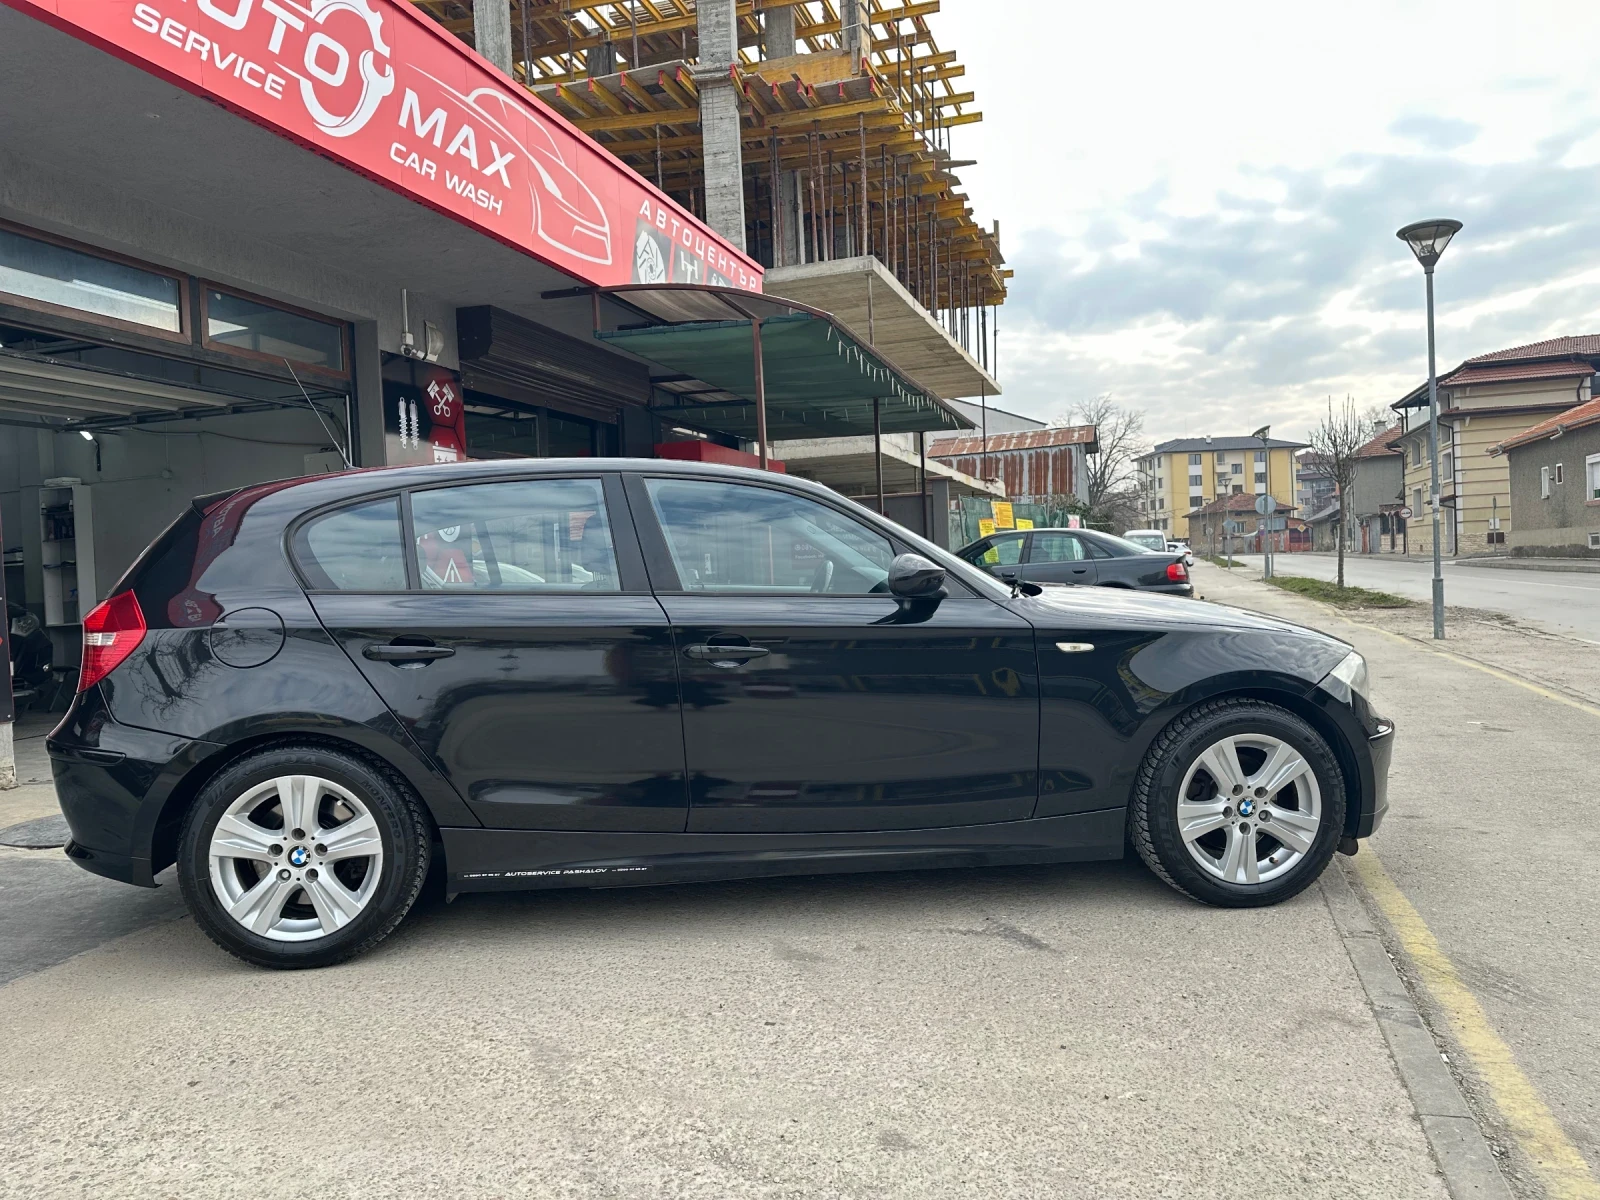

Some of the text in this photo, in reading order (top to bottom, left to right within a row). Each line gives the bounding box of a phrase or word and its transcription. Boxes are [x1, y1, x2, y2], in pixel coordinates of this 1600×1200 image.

[132, 3, 286, 100] SERVICE
[178, 0, 516, 190] UTO MAX
[390, 142, 503, 216] CAR WASH
[639, 199, 757, 289] АВТОЦЕНТЪР
[504, 869, 561, 877] AUTOSERVICE
